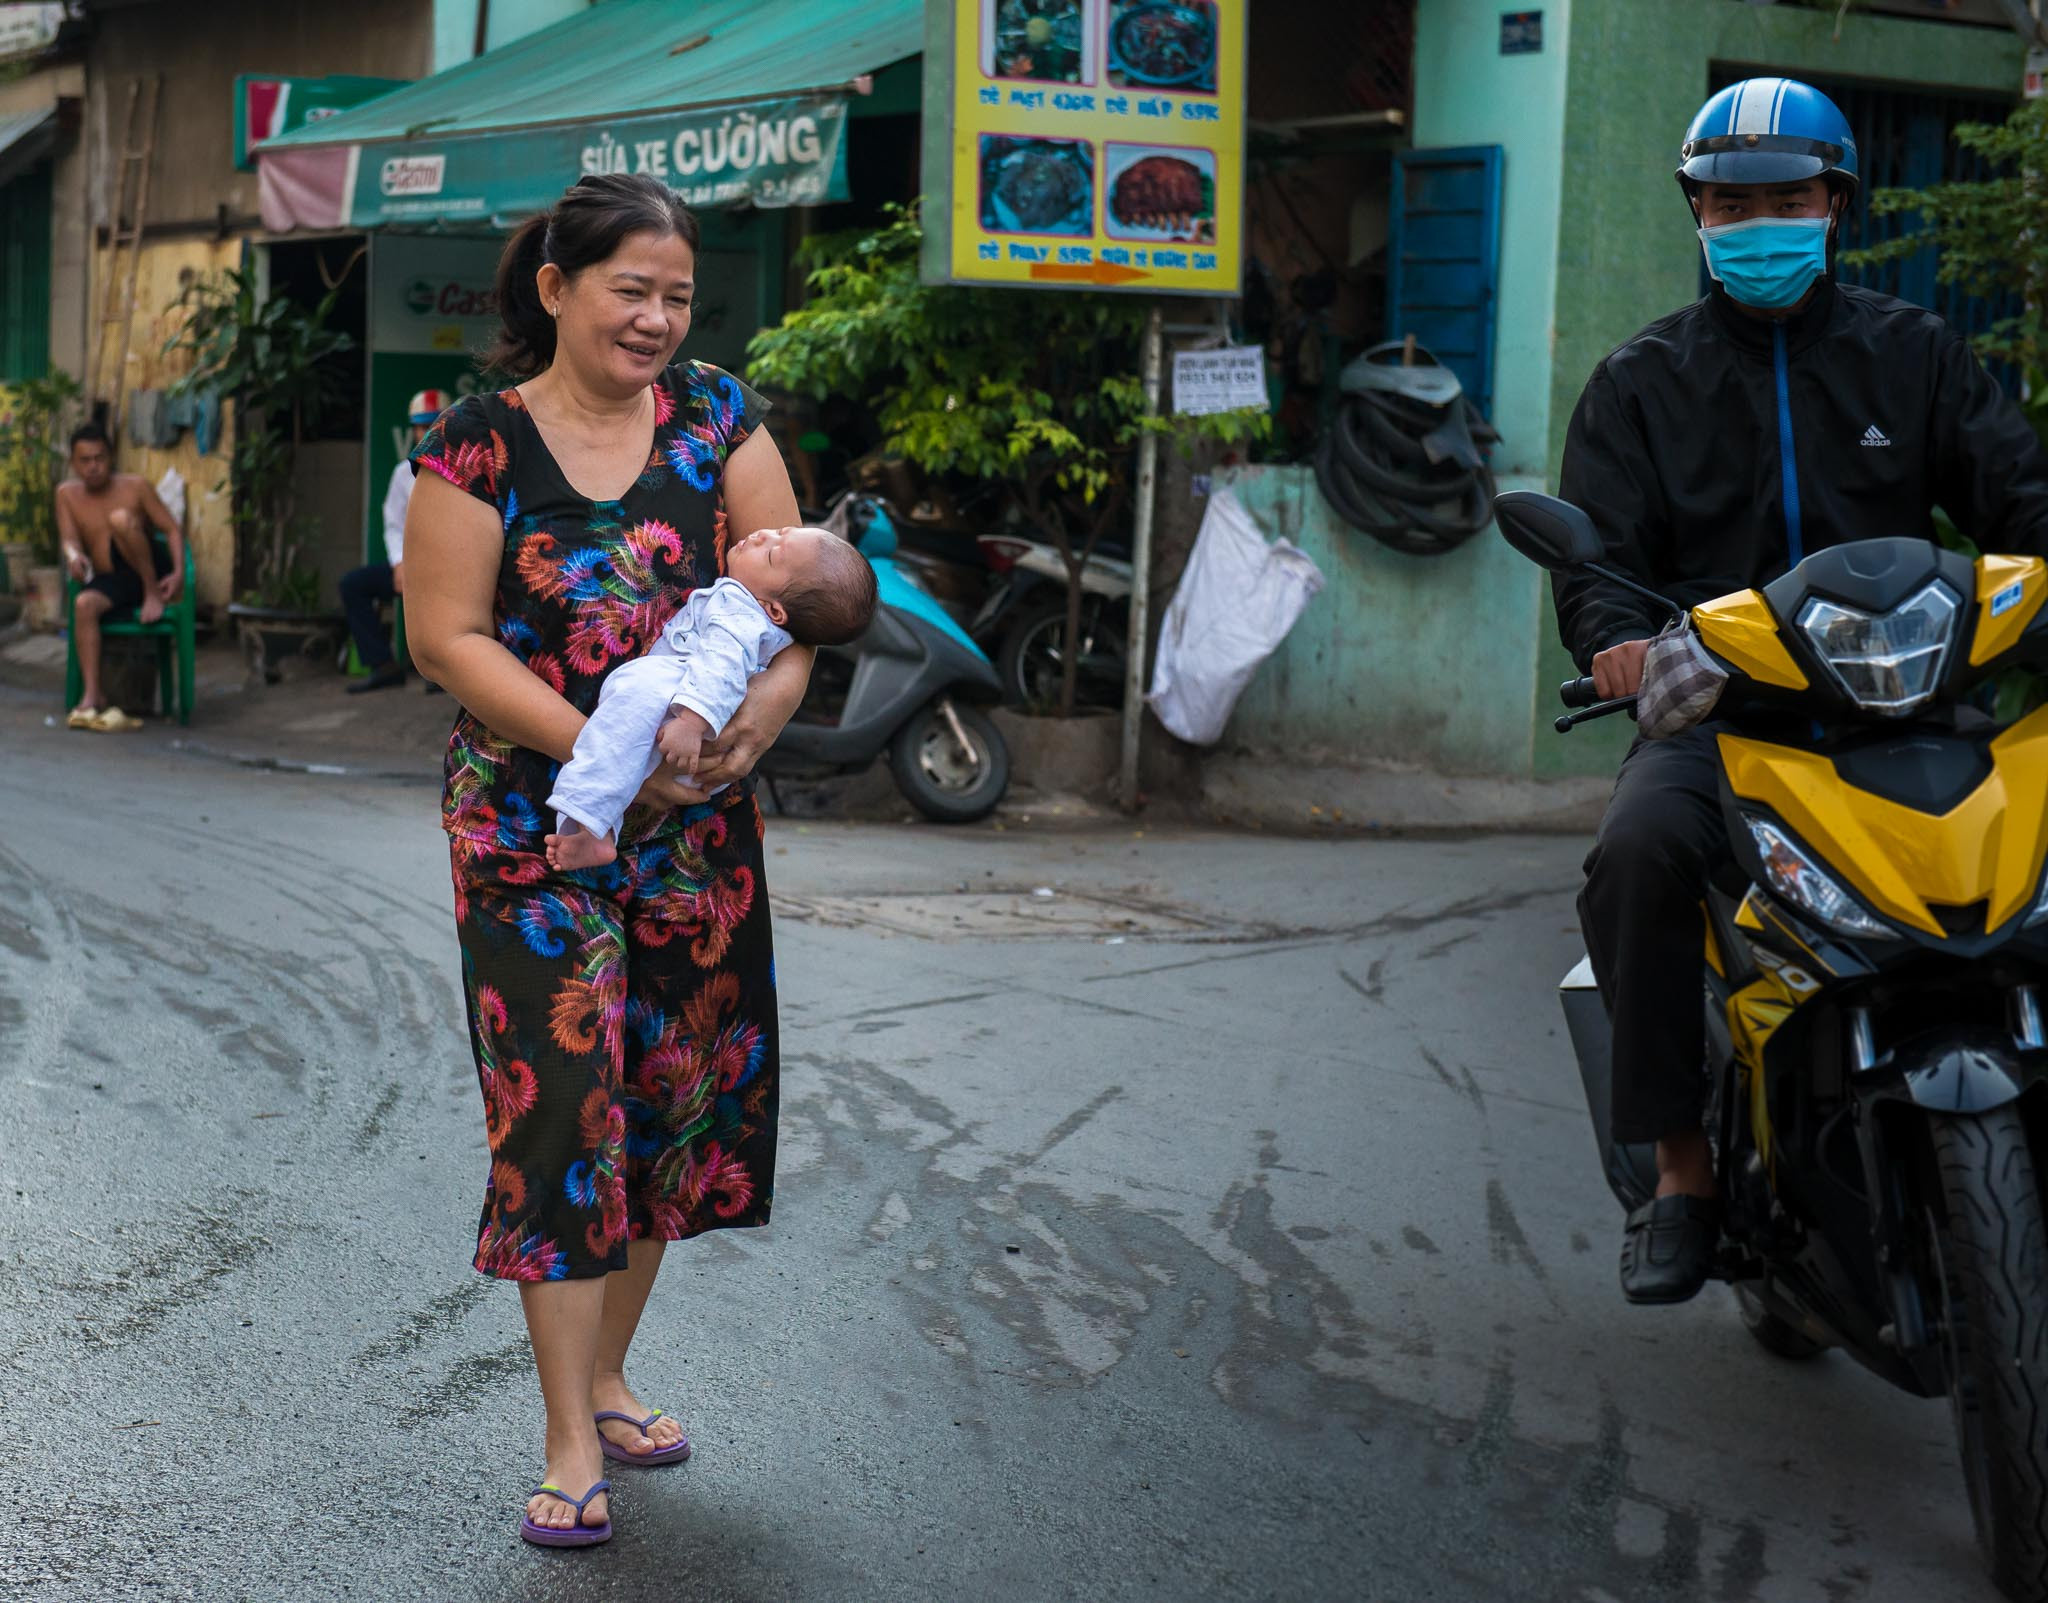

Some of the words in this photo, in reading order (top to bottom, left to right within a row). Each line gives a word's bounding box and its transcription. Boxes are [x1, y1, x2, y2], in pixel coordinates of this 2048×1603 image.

[581, 132, 628, 178] SỬA
[634, 139, 668, 177] XE
[673, 112, 821, 176] CƯỜNG
[1860, 437, 1891, 446] adidas
[1752, 945, 1822, 993] 50
